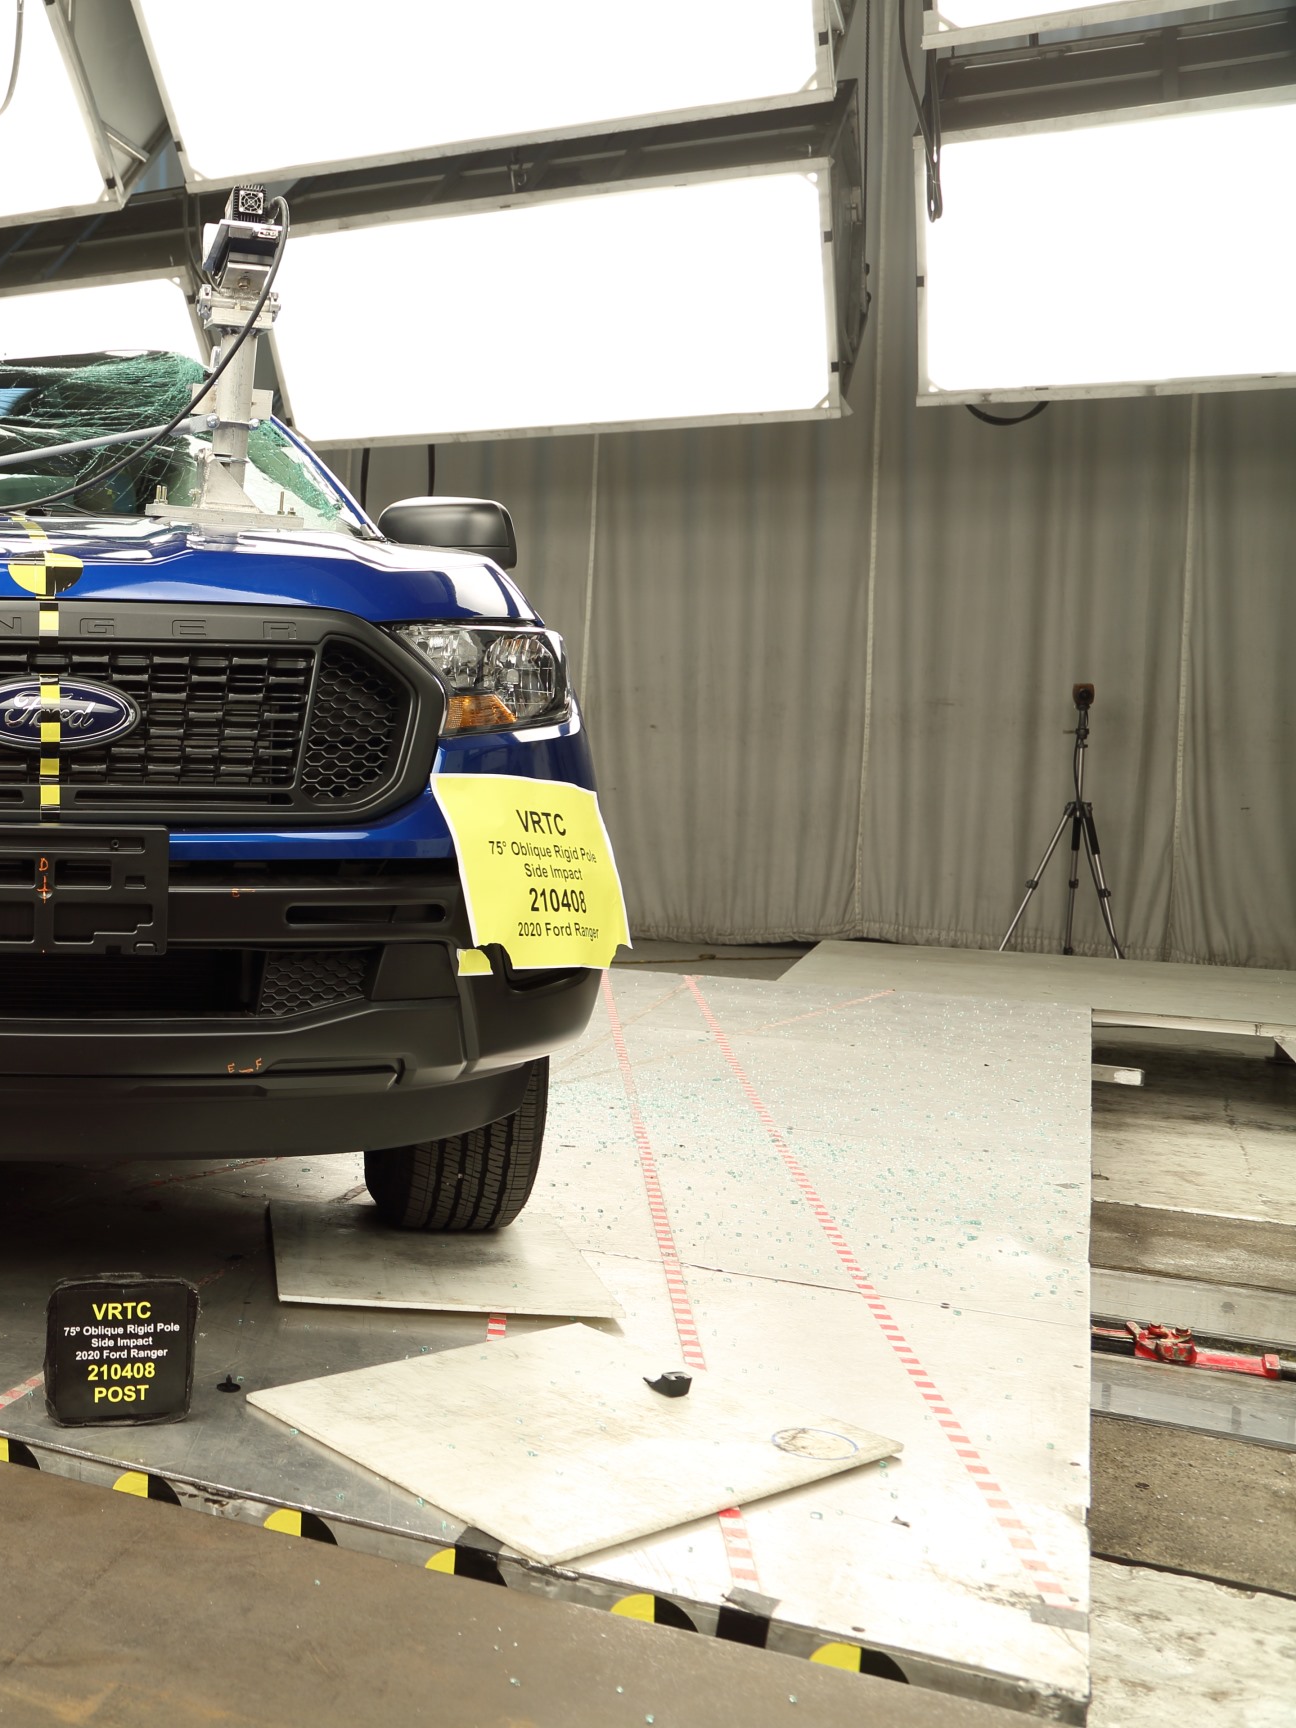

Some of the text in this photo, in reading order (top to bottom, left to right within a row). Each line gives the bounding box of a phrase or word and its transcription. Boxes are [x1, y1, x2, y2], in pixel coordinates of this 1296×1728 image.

[516, 809, 567, 836] VRTC
[511, 841, 552, 860] Oblique
[554, 844, 579, 863] Rigid
[580, 847, 597, 863] Pole
[524, 862, 583, 882] Side Impact
[529, 887, 587, 913] 210408
[517, 921, 599, 942] 2020 Ford Ranger
[92, 1301, 152, 1321] VRTC
[83, 1325, 124, 1336] Oblique
[127, 1323, 154, 1335] Rigid
[157, 1322, 180, 1332] Pole
[91, 1336, 153, 1348] Side Impact
[75, 1348, 168, 1360] 2020 Ford Ranger
[87, 1362, 155, 1381] 210408
[94, 1384, 149, 1403] POST
